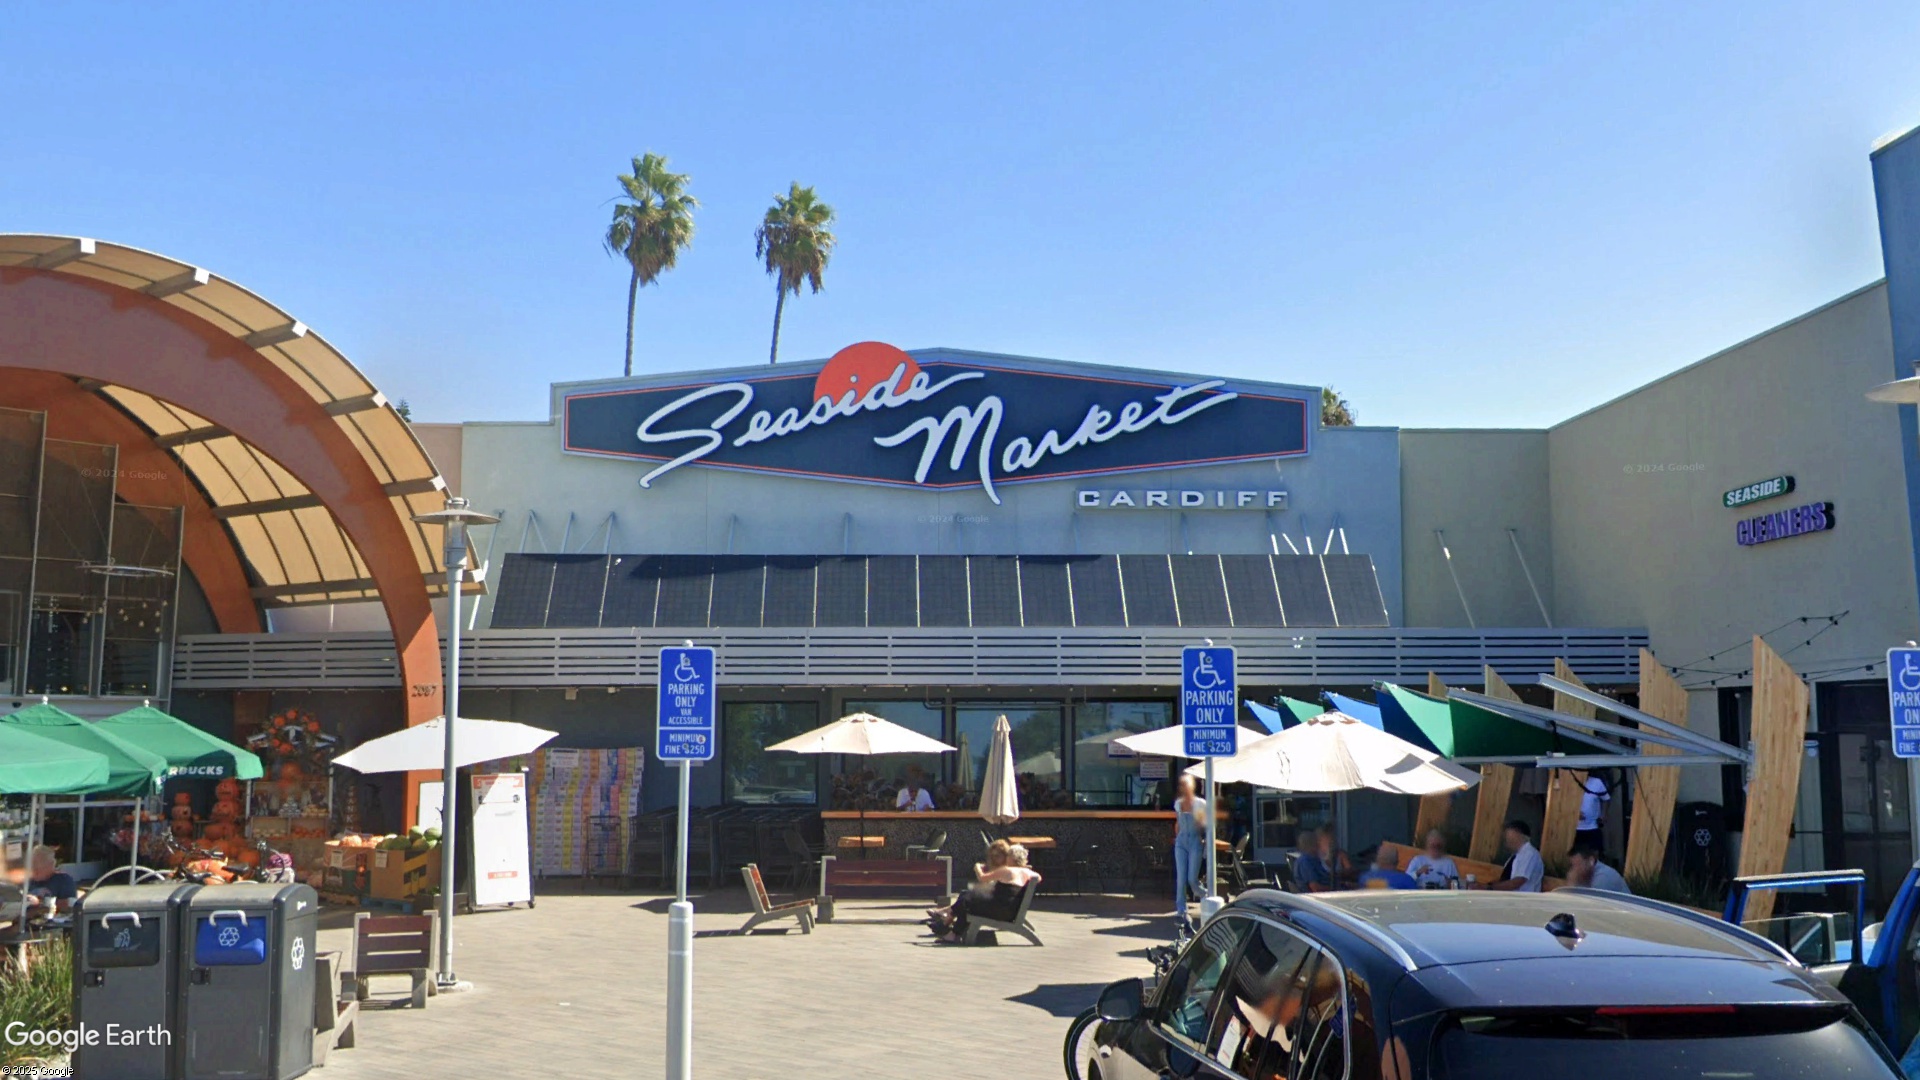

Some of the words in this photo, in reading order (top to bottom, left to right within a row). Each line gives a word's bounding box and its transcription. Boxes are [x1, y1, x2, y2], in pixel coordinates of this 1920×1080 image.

[637, 362, 985, 489] Seaside
[874, 379, 1238, 505] Market
[1726, 477, 1782, 506] SEASIDE
[1078, 490, 1289, 507] CARDIFF
[1736, 501, 1828, 546] CLEANERS
[668, 683, 705, 695] PARKING
[675, 696, 698, 708] ONLY
[1185, 690, 1234, 706] PARKING
[680, 707, 692, 716] VAN
[1195, 708, 1225, 723] ONLY
[668, 716, 704, 725] ACCESSIBLE
[669, 733, 705, 743] MINIMU
[1193, 729, 1227, 740] MINIMUM
[664, 744, 681, 755] FINE
[1189, 742, 1206, 753] FINE
[1899, 742, 1917, 753] FINE
